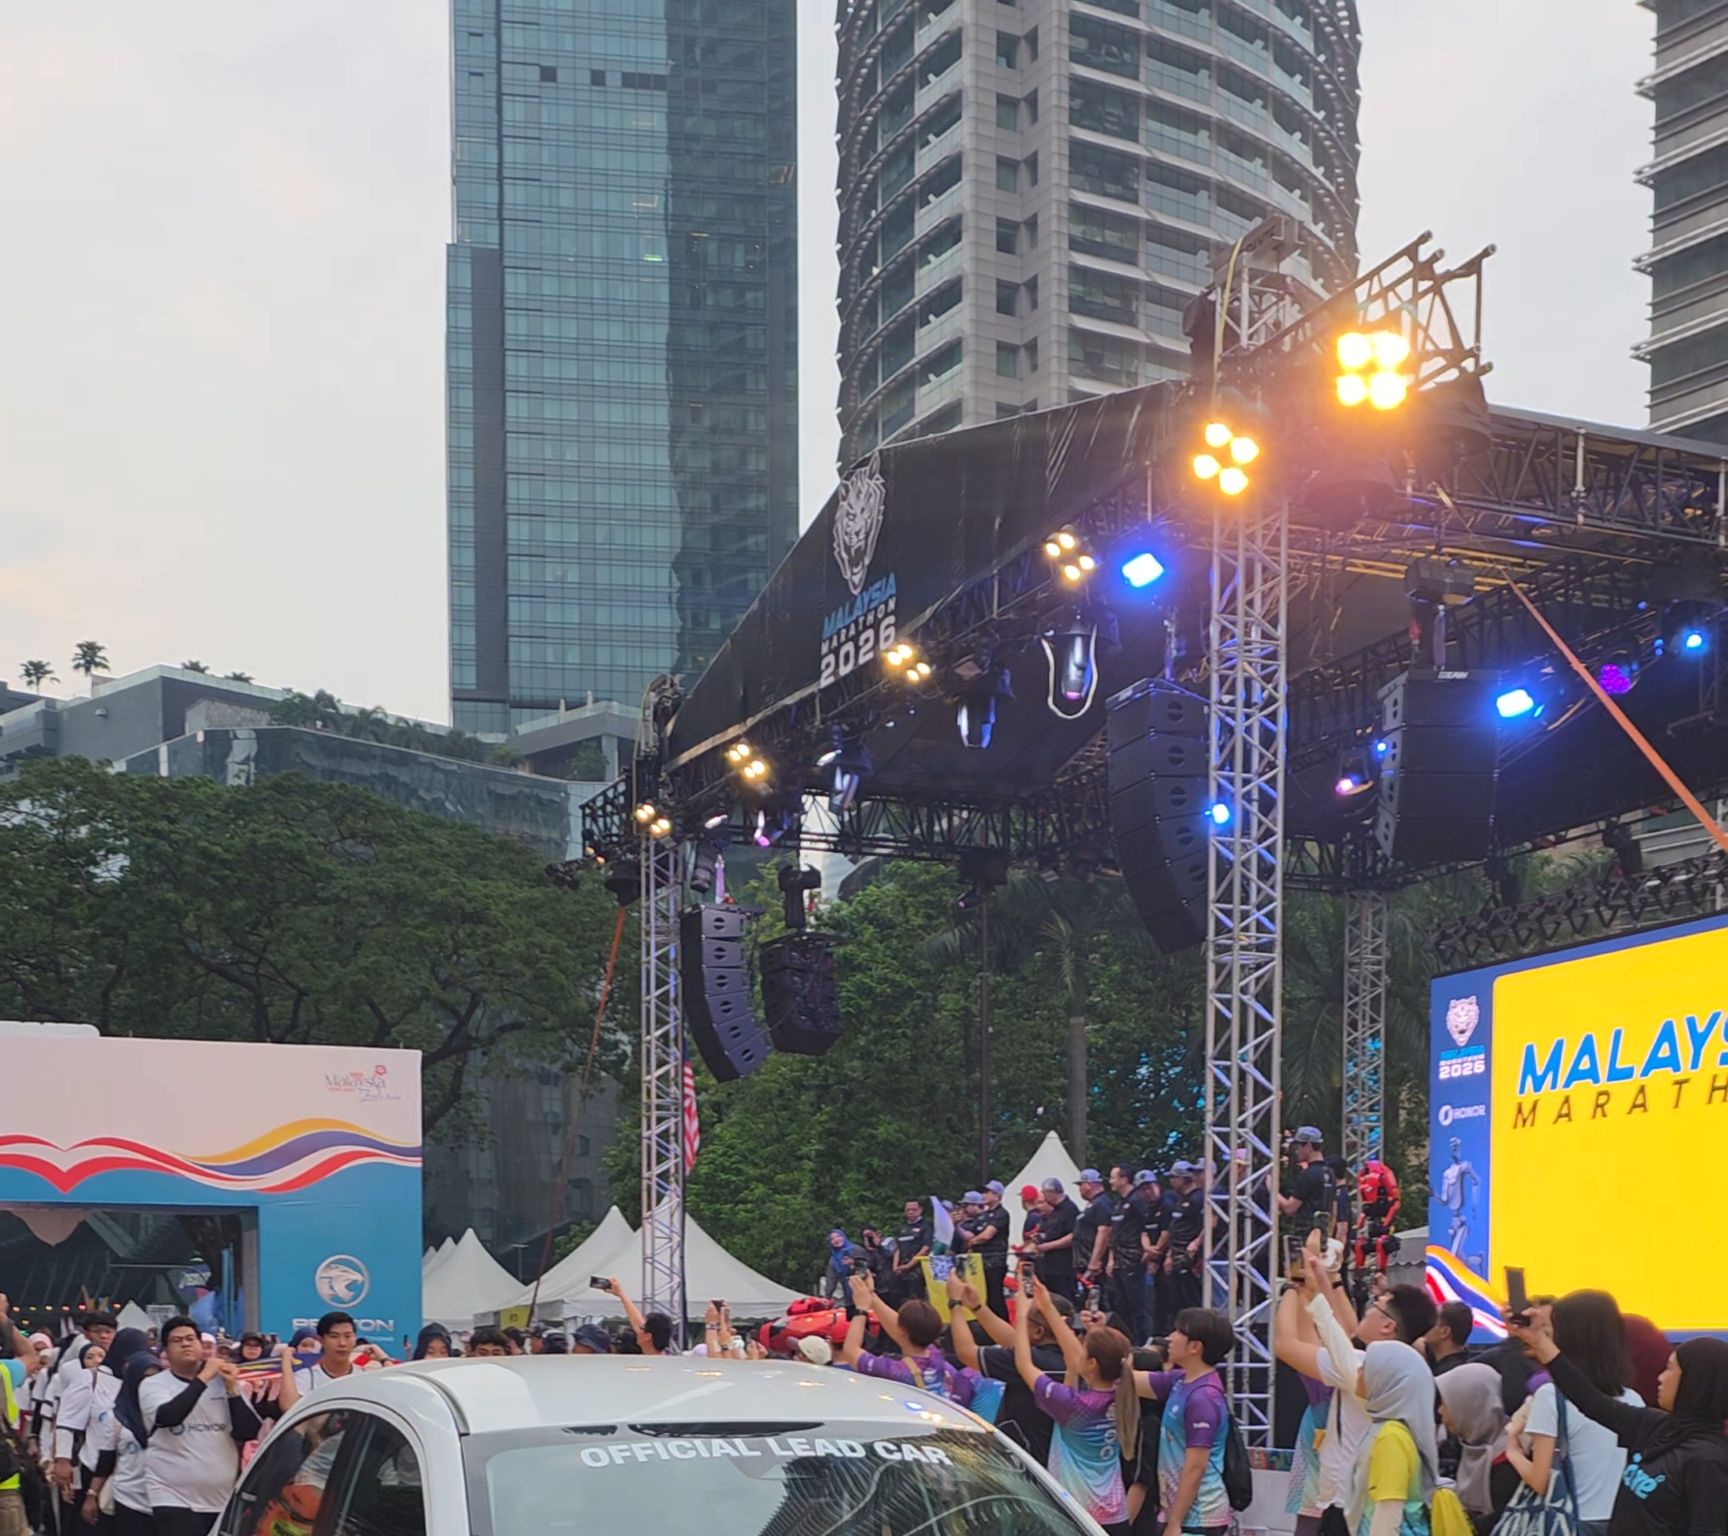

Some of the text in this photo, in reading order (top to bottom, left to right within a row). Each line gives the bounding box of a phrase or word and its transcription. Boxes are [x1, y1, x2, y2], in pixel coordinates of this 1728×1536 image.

[821, 596, 897, 655] MARATHON
[822, 571, 897, 640] MALAYSIA
[820, 614, 896, 689] 2026
[1438, 1061, 1486, 1080] 2026
[187, 1423, 227, 1433] HONOR
[580, 1437, 954, 1468] OFFICIAL LEAD CAR
